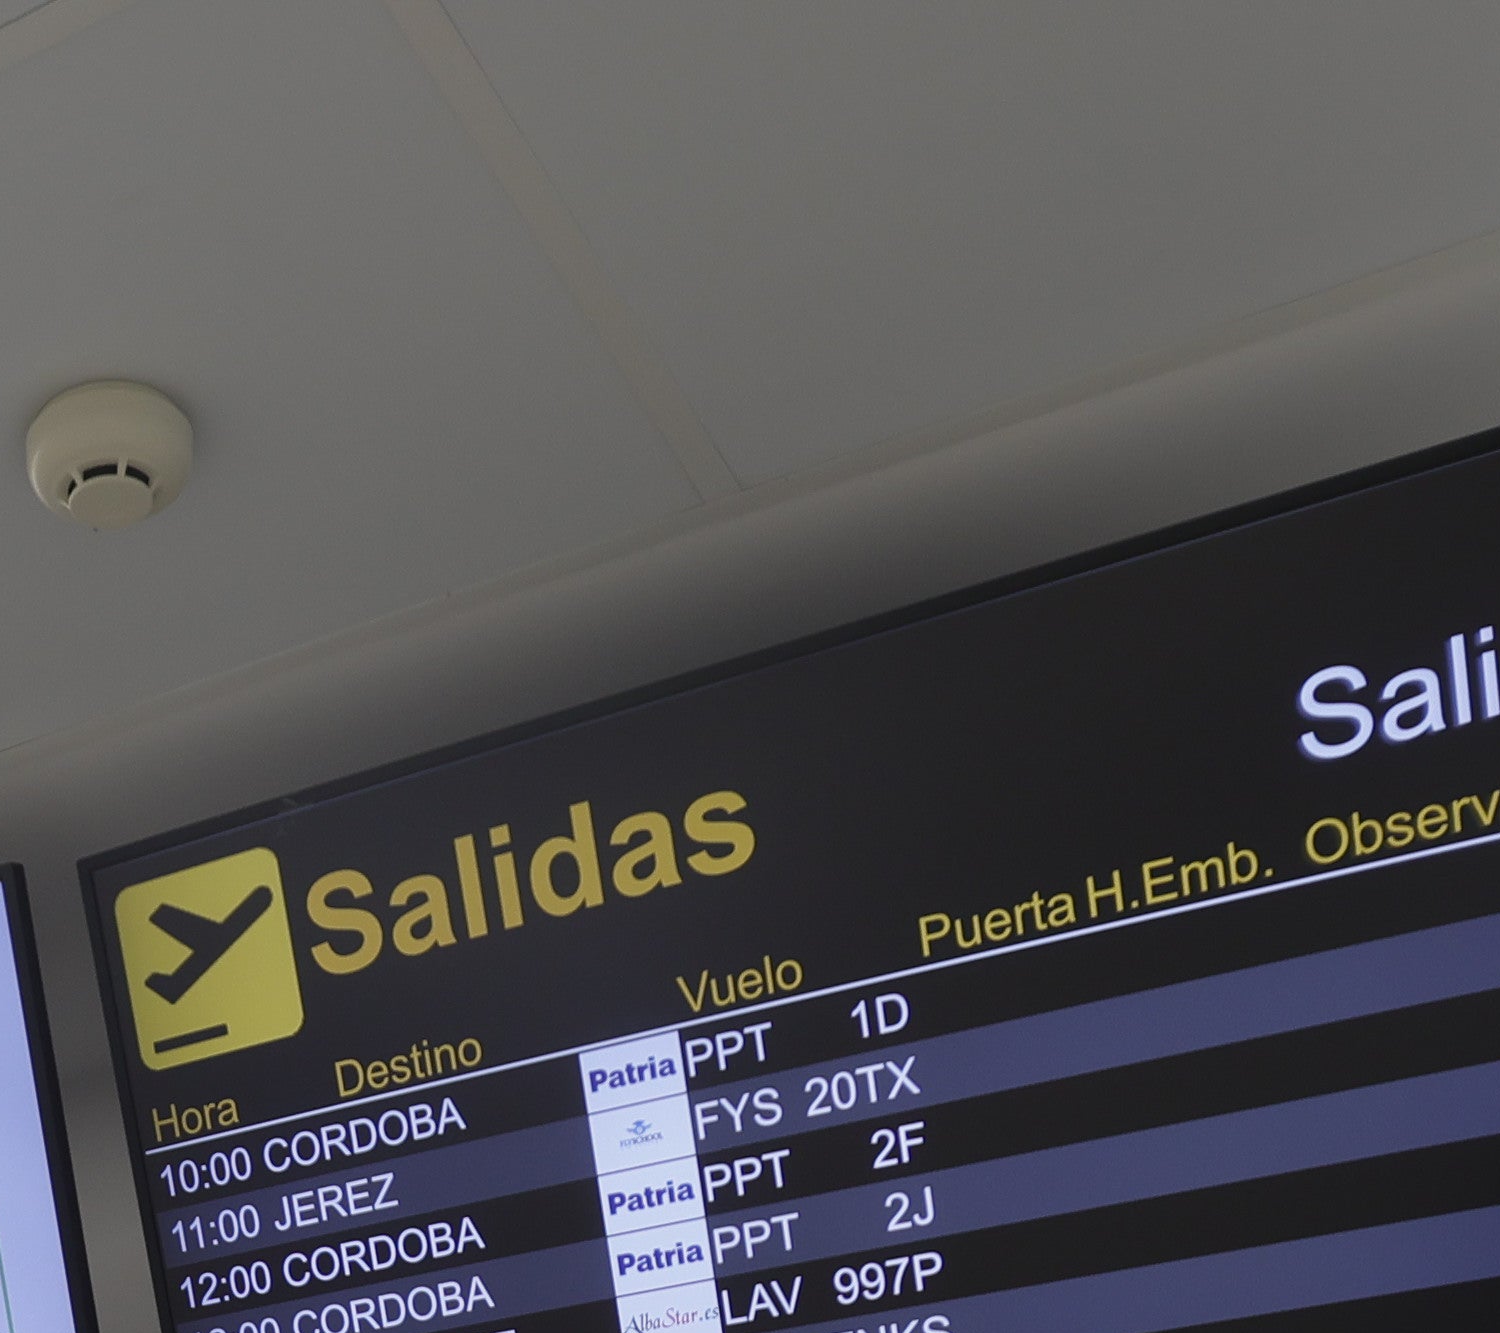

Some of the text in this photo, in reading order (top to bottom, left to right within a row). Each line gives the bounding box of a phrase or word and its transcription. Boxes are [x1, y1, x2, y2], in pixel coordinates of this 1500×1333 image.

[306, 790, 755, 975] Salidas
[152, 1098, 240, 1142] Hora
[334, 1034, 482, 1098] Destino
[676, 955, 803, 1013] Vuelo
[919, 891, 1076, 958] Puerta
[1086, 841, 1273, 918] H.Emb.
[160, 993, 909, 1197] 10:00 CORDOBA Patria PPT 1D
[171, 1204, 260, 1253] 11:00
[274, 1172, 399, 1231] JEREZ
[694, 1087, 783, 1141] FYS
[804, 1055, 921, 1117] 20TX
[180, 1121, 924, 1309] 12:00 CORDOBA Patria PPT 2F
[616, 1241, 705, 1277] Patria
[712, 1212, 799, 1265] PPT
[884, 1185, 934, 1232] 2J
[721, 1275, 802, 1326] LAV
[833, 1252, 943, 1305] 997P
